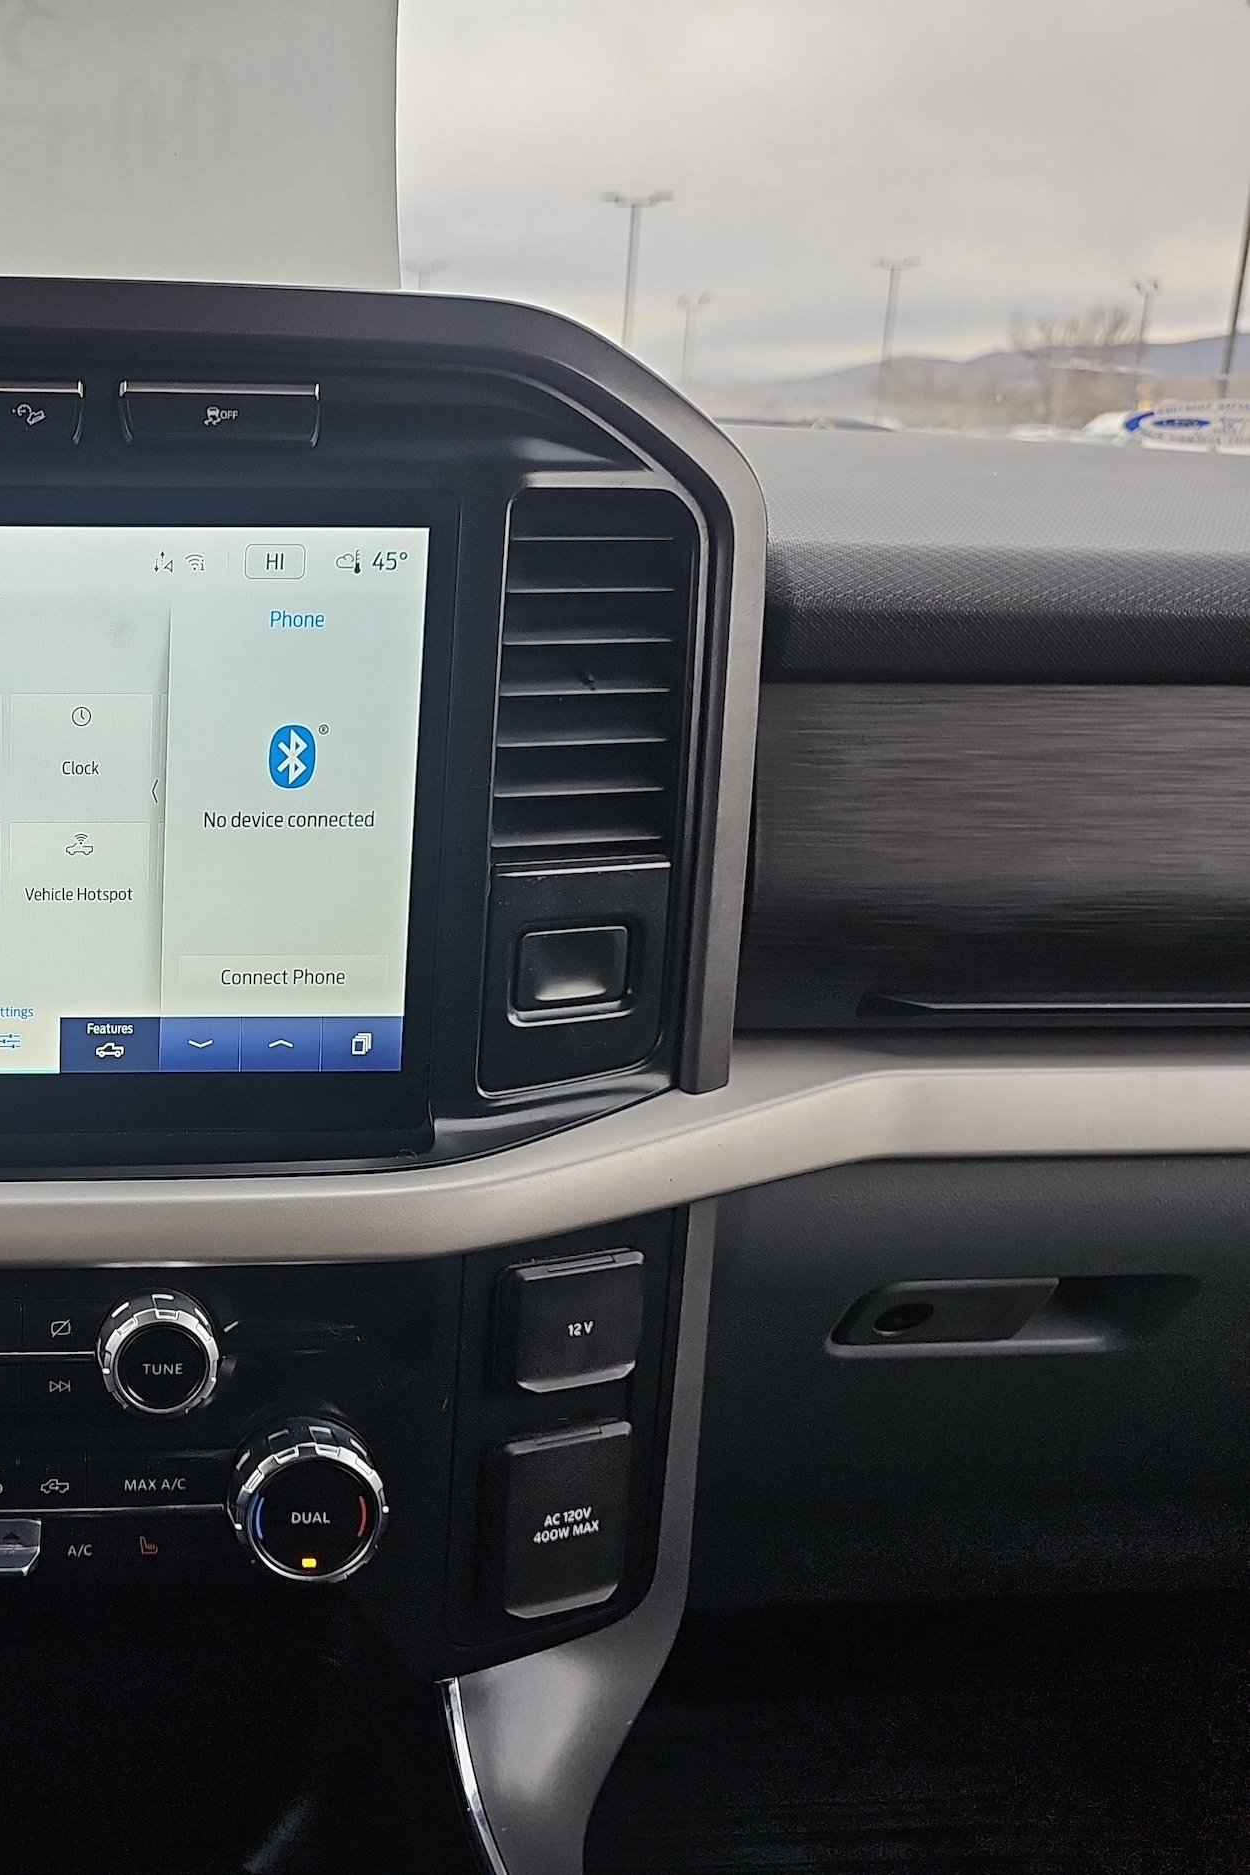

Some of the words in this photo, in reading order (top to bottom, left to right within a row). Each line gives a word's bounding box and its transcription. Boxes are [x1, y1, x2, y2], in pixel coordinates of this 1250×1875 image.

[219, 409, 239, 421] OFF
[265, 552, 285, 571] HI
[371, 550, 409, 571] 45°
[269, 610, 326, 629] Phone
[61, 760, 100, 777] Clock
[203, 812, 226, 829] No
[229, 811, 284, 829] device
[287, 811, 376, 828] connected
[24, 887, 74, 902] Vehicle
[77, 886, 134, 904] Hotspot
[220, 969, 289, 986] Connect
[292, 969, 346, 986] Phone
[86, 1021, 134, 1036] Features
[141, 1362, 184, 1377] TUNE
[124, 1478, 157, 1492] MAX
[160, 1477, 187, 1491] A/C
[290, 1511, 331, 1525] DUAL
[543, 1511, 561, 1527] AC
[562, 1506, 592, 1523] 120V
[533, 1524, 571, 1545] 400W
[572, 1519, 600, 1536] MAX
[67, 1543, 93, 1558] A/C
